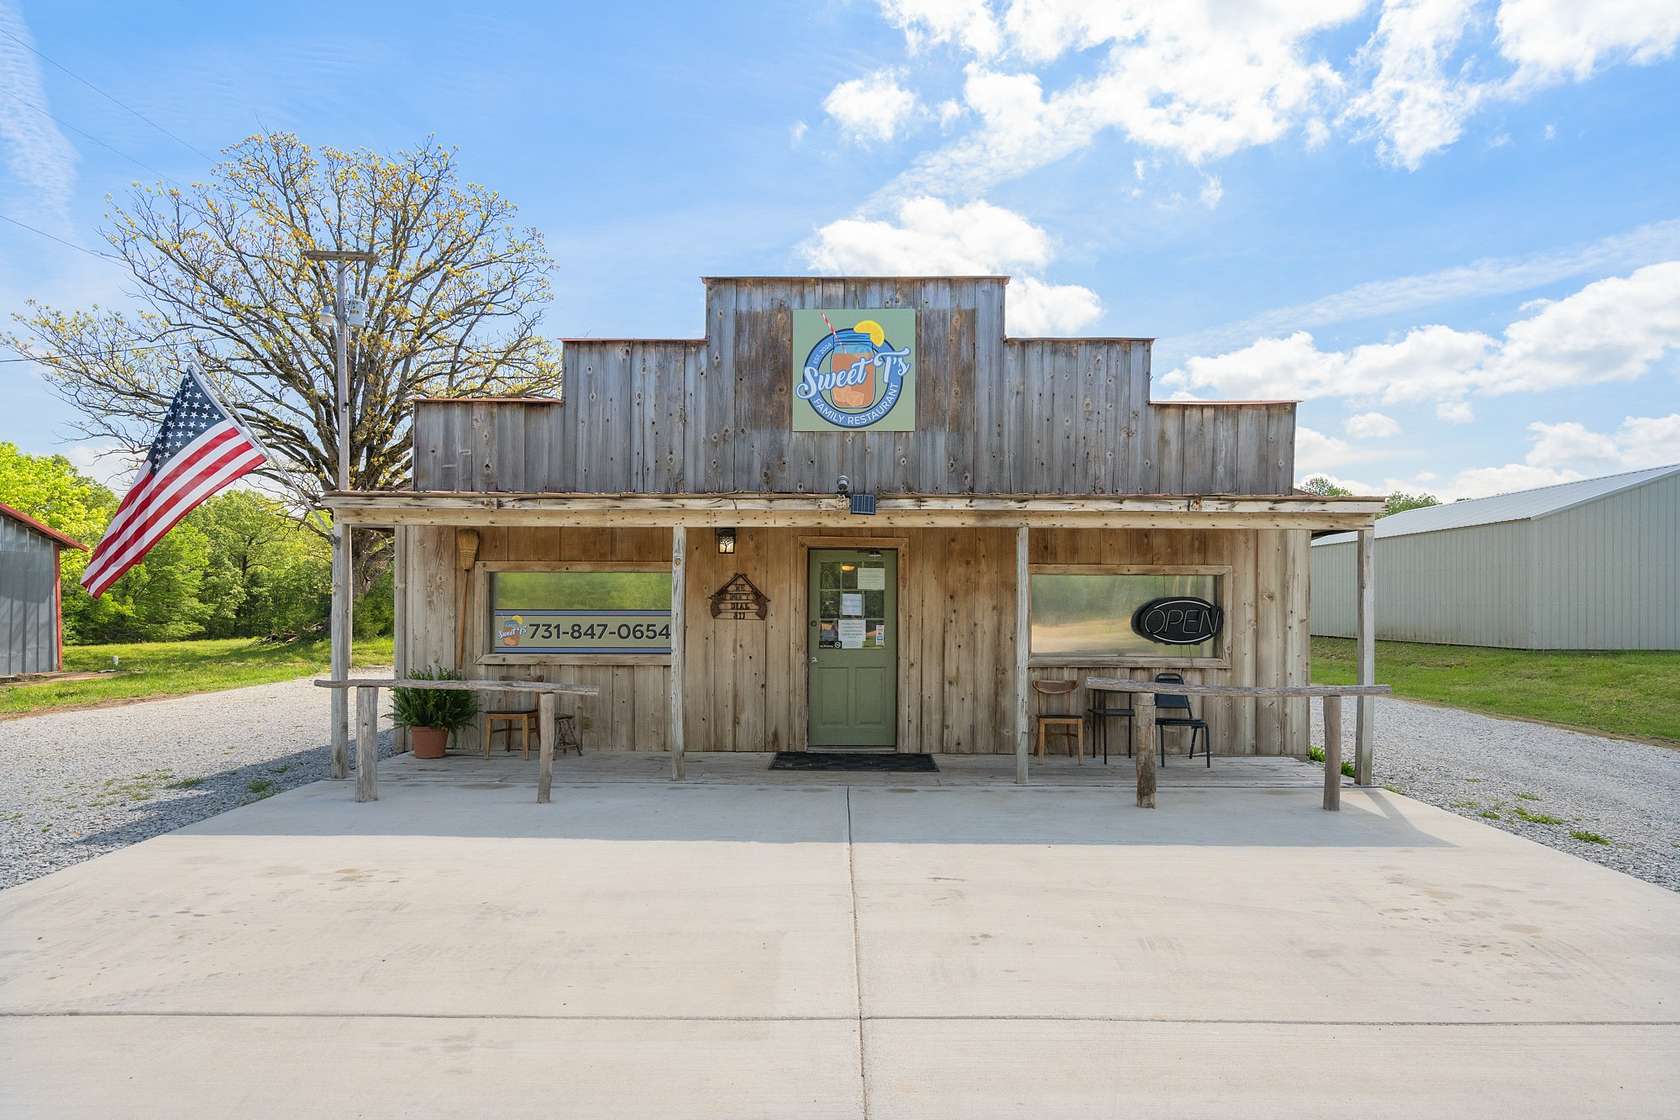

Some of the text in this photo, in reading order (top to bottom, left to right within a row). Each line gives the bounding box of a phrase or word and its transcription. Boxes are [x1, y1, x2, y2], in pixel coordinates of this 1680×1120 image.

[797, 348, 910, 398] Sweet T's
[813, 383, 899, 425] FAMILY RESTAURANT
[529, 623, 671, 640] 731-847-0654
[1145, 609, 1220, 634] OPEN
